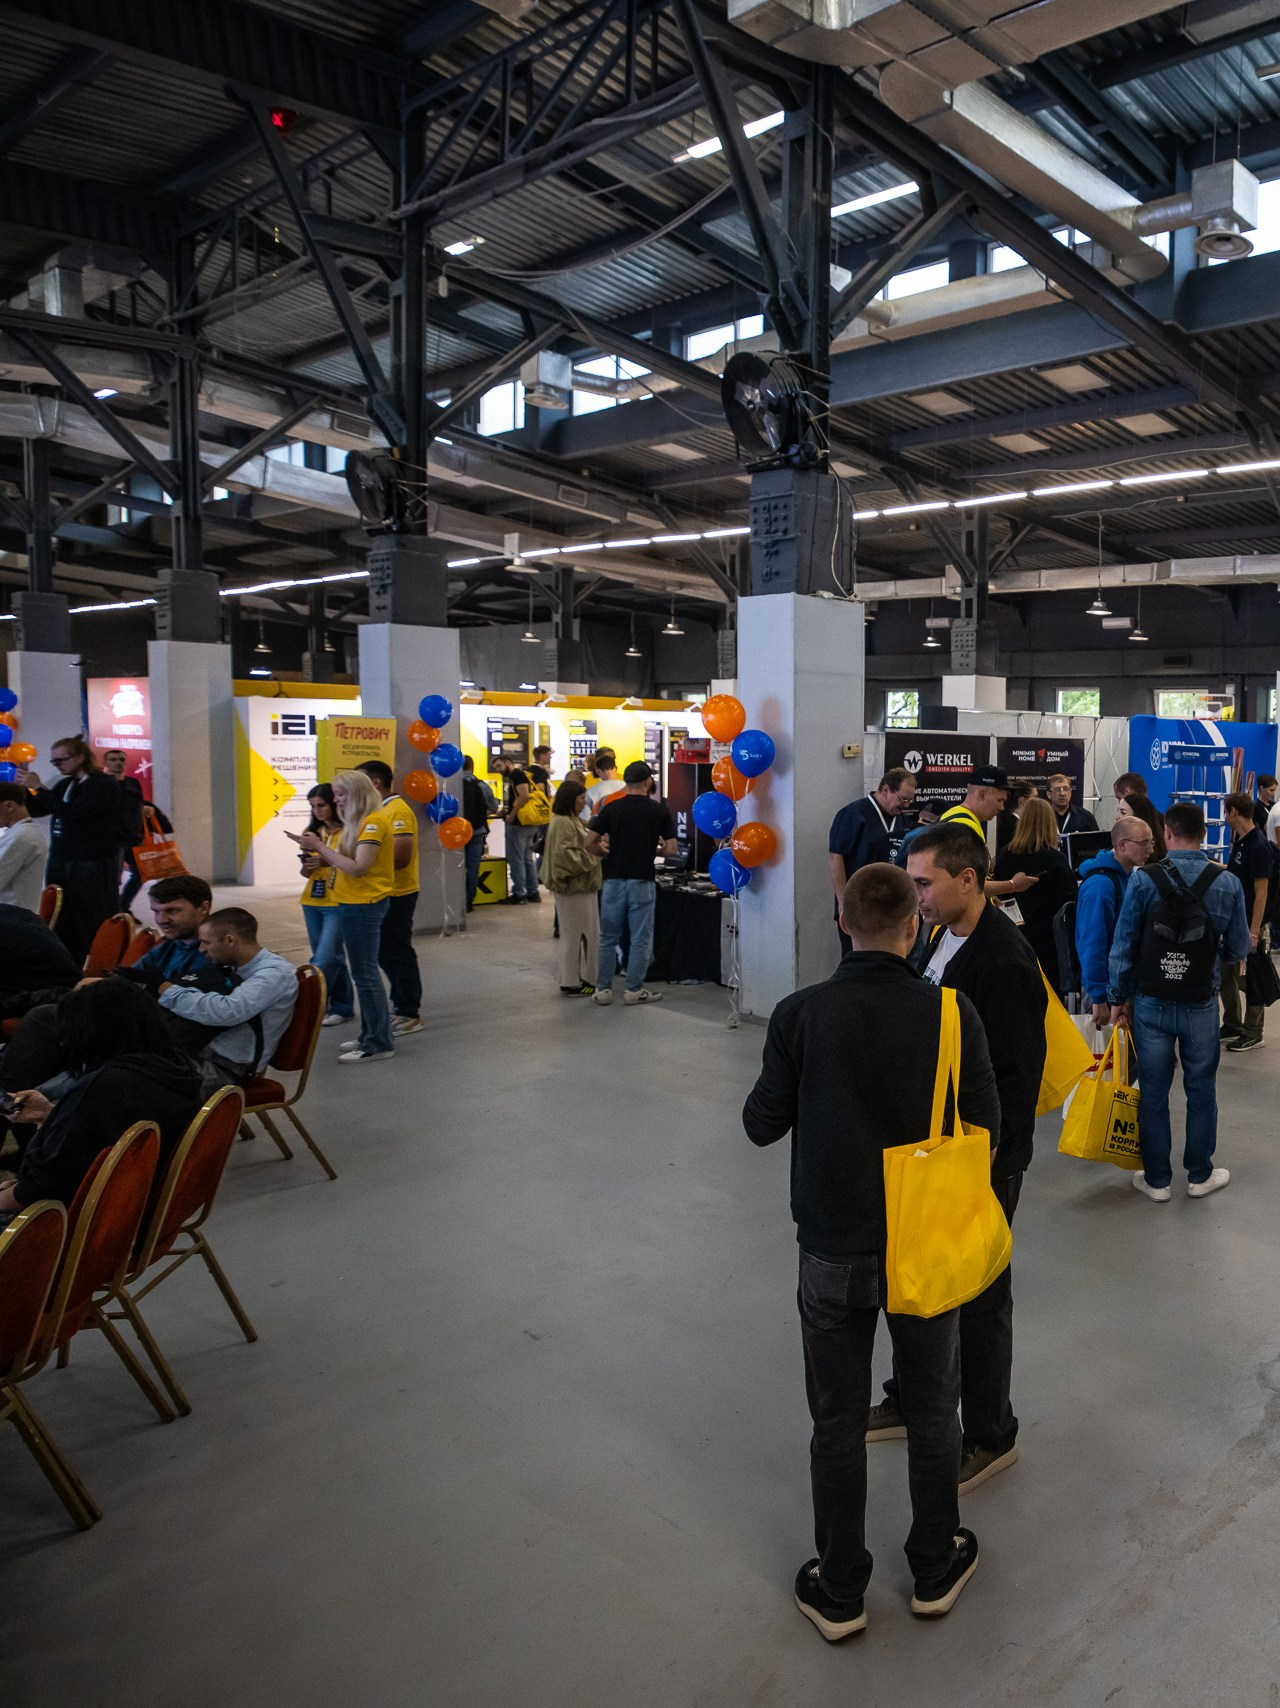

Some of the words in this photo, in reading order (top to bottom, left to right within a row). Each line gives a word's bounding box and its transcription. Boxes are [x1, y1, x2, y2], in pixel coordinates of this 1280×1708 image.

[926, 754, 974, 766] WERKEL
[1110, 1134, 1141, 1148] КОРПУ
[1116, 1145, 1141, 1156] РОССИ
